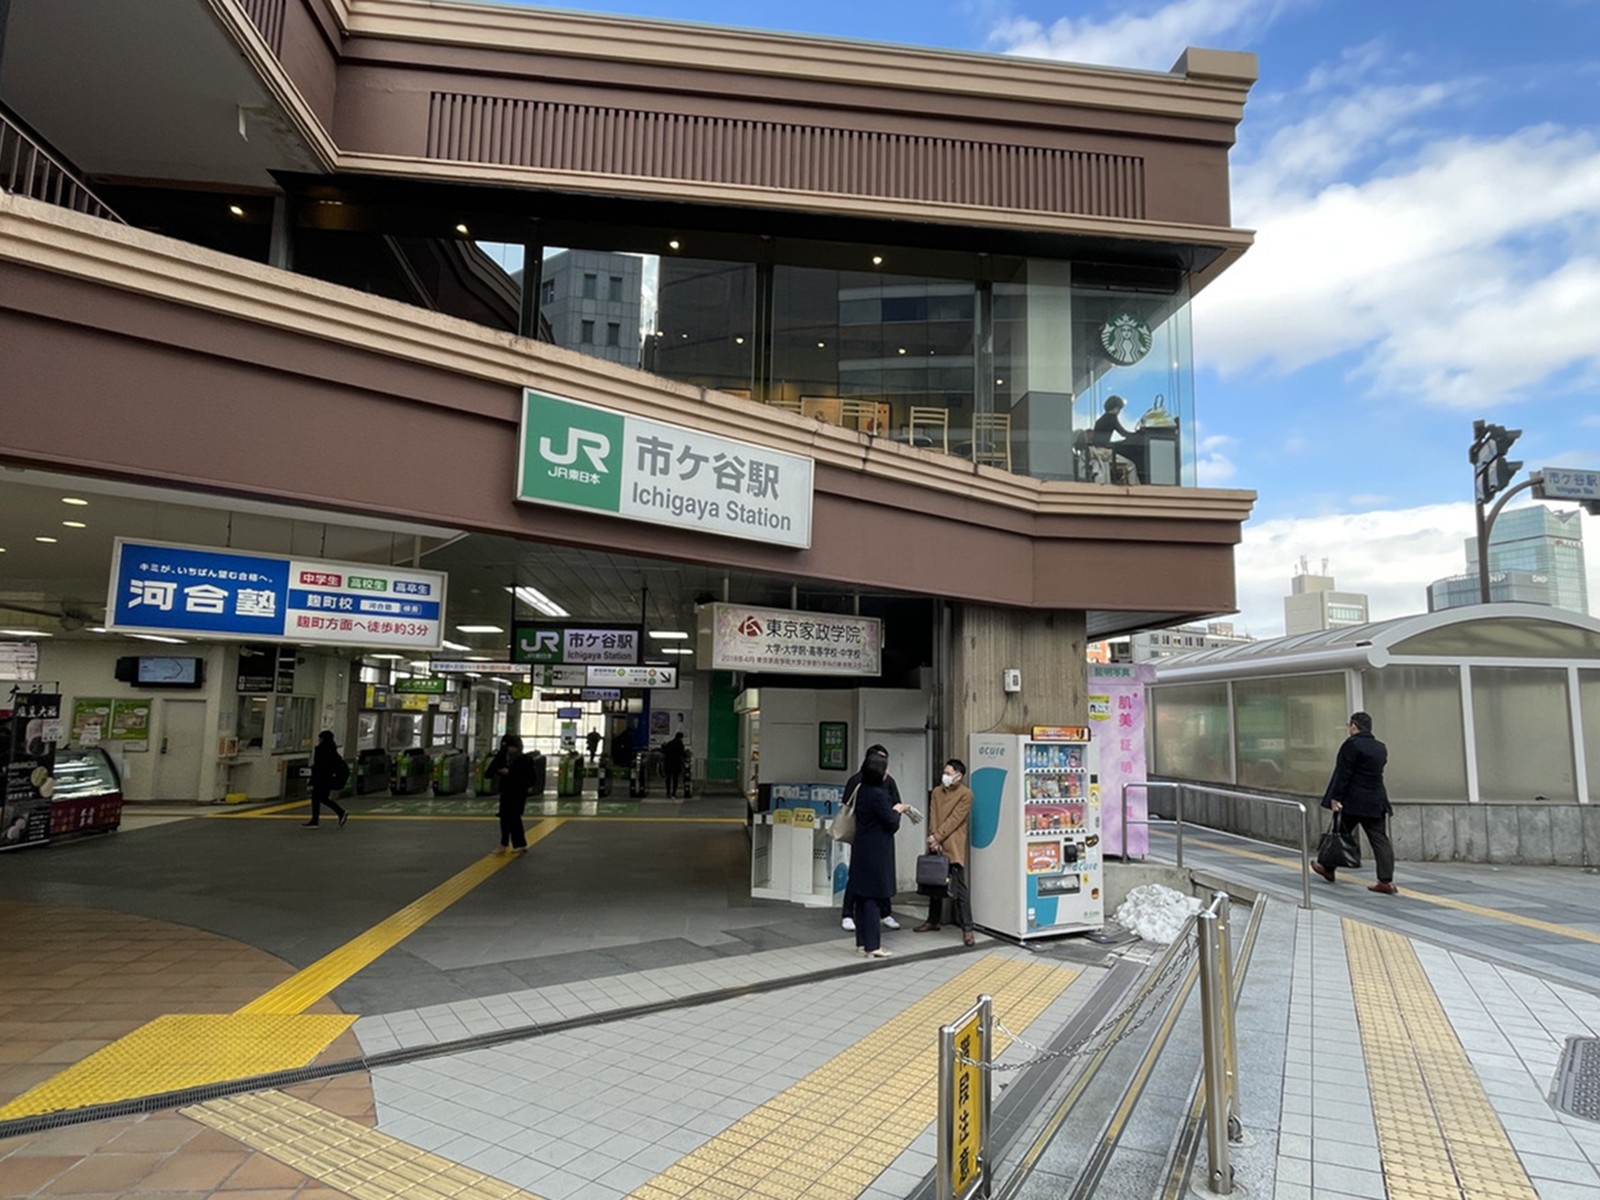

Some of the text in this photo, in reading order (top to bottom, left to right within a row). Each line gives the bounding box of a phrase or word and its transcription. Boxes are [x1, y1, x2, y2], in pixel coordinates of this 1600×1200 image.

[539, 427, 611, 473] JR
[547, 468, 601, 485] JR東日本
[636, 436, 779, 501] 市ケ谷駅
[632, 482, 791, 531] Ichigaya Station
[303, 573, 429, 595] 中学生 高校生 高卒生
[128, 578, 276, 618] 河合塾
[521, 631, 560, 652] JR
[569, 633, 633, 649] 市ケ谷駅
[766, 618, 861, 644] 東京家政学院
[567, 650, 632, 662] Ichigaya Station
